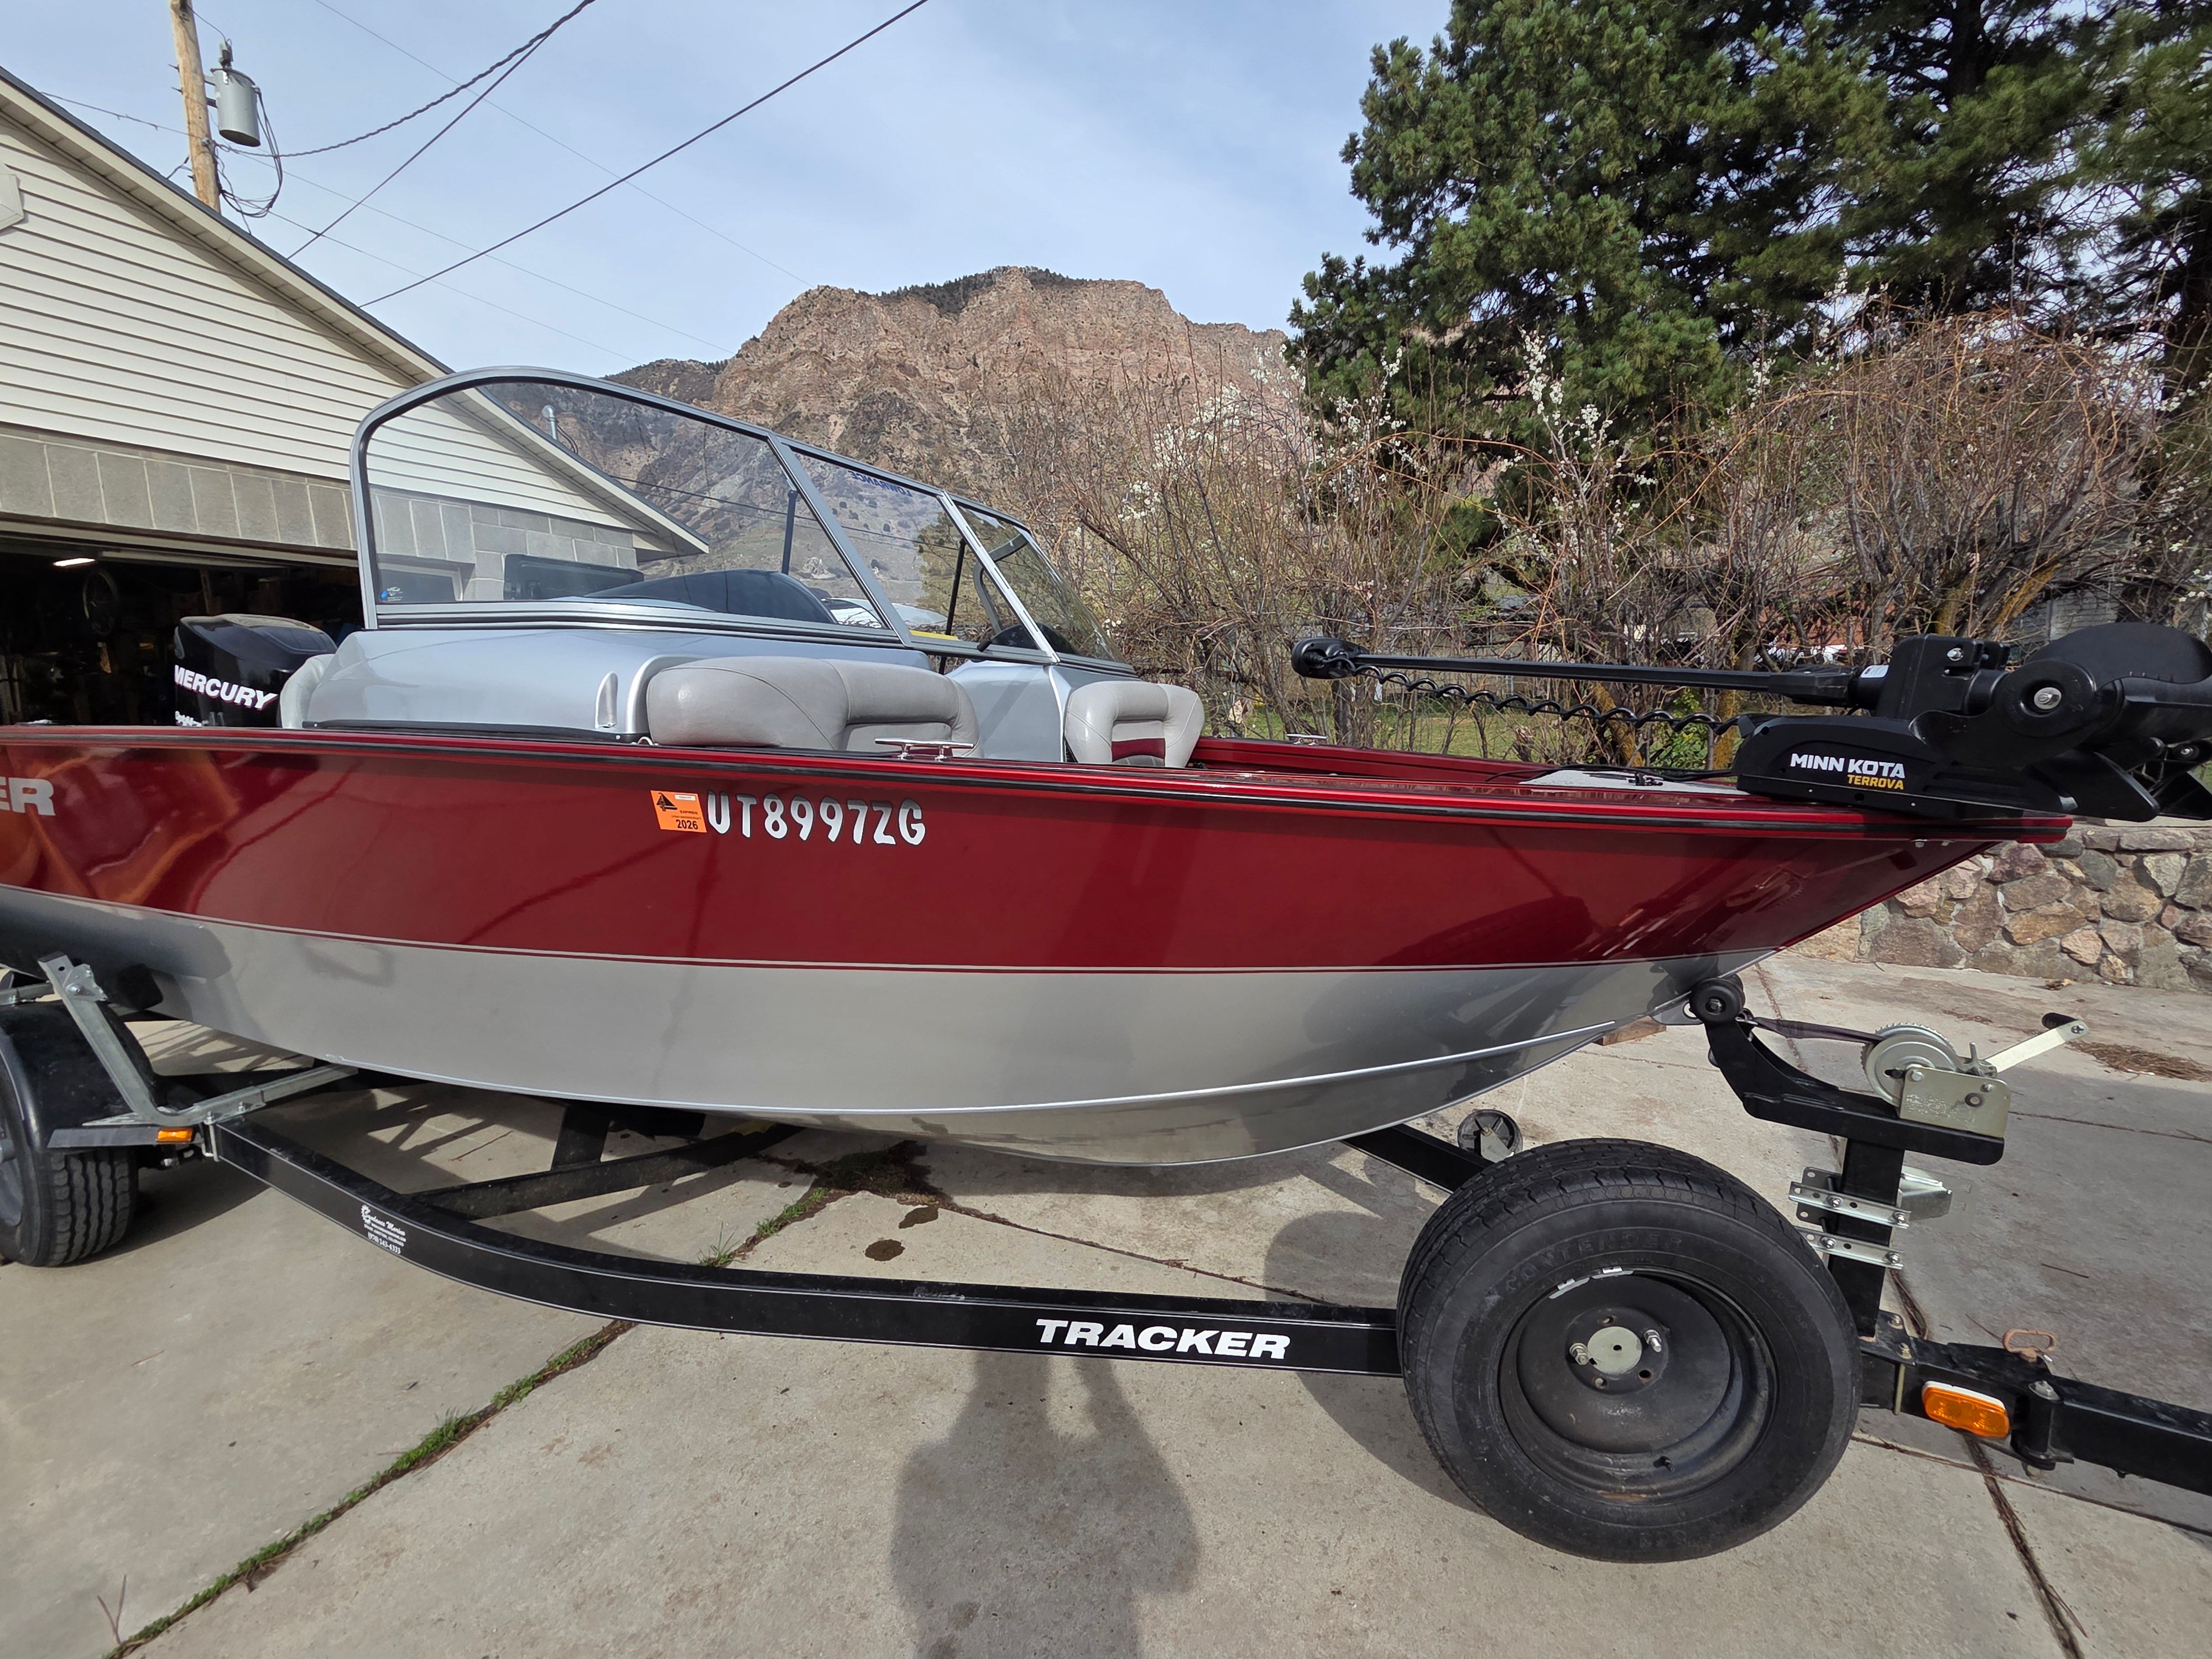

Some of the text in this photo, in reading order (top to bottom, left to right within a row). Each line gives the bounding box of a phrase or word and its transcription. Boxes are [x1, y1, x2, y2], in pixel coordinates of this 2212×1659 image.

[174, 664, 278, 710] MERCURY
[1790, 753, 1906, 779] MINN KOTA
[1847, 774, 1904, 790] TERROVA
[0, 776, 56, 816] R
[676, 819, 698, 830] 2026
[1036, 1319, 1291, 1359] TRACKER
